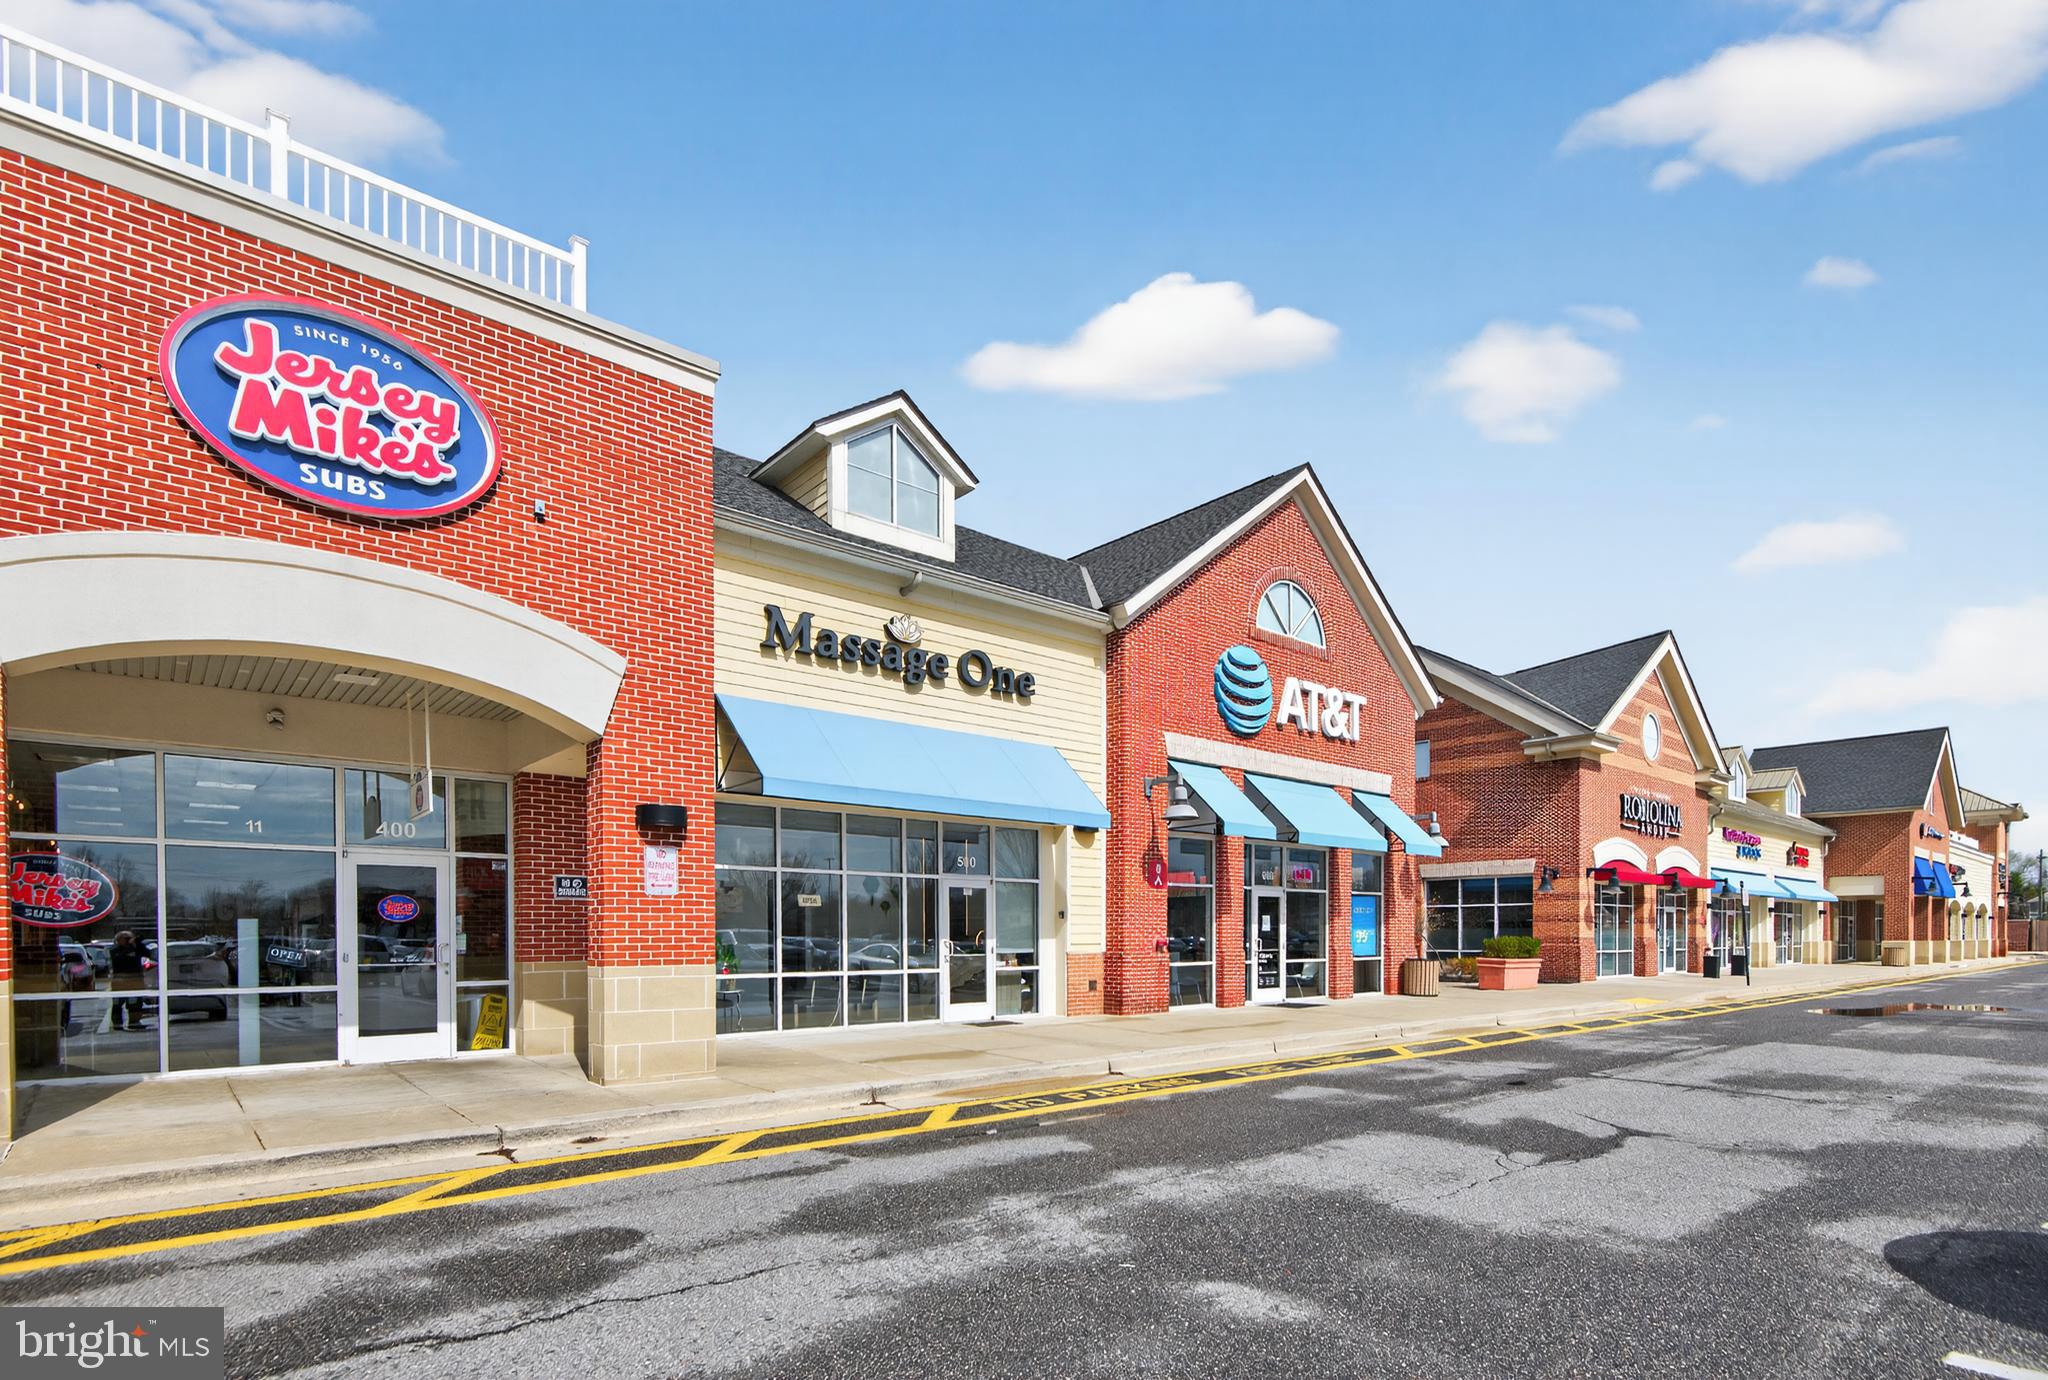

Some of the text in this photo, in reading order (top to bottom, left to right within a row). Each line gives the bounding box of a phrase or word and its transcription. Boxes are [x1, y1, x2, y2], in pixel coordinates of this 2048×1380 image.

[294, 325, 403, 371] SINCE 1956
[214, 318, 461, 451] Jersey
[228, 375, 458, 484] Mike's
[300, 463, 387, 500] SUBS
[760, 604, 1036, 697] Massage One
[1277, 677, 1367, 743] AT&T
[245, 820, 262, 833] 11
[376, 821, 416, 839] 400
[271, 948, 303, 961] OPEN
